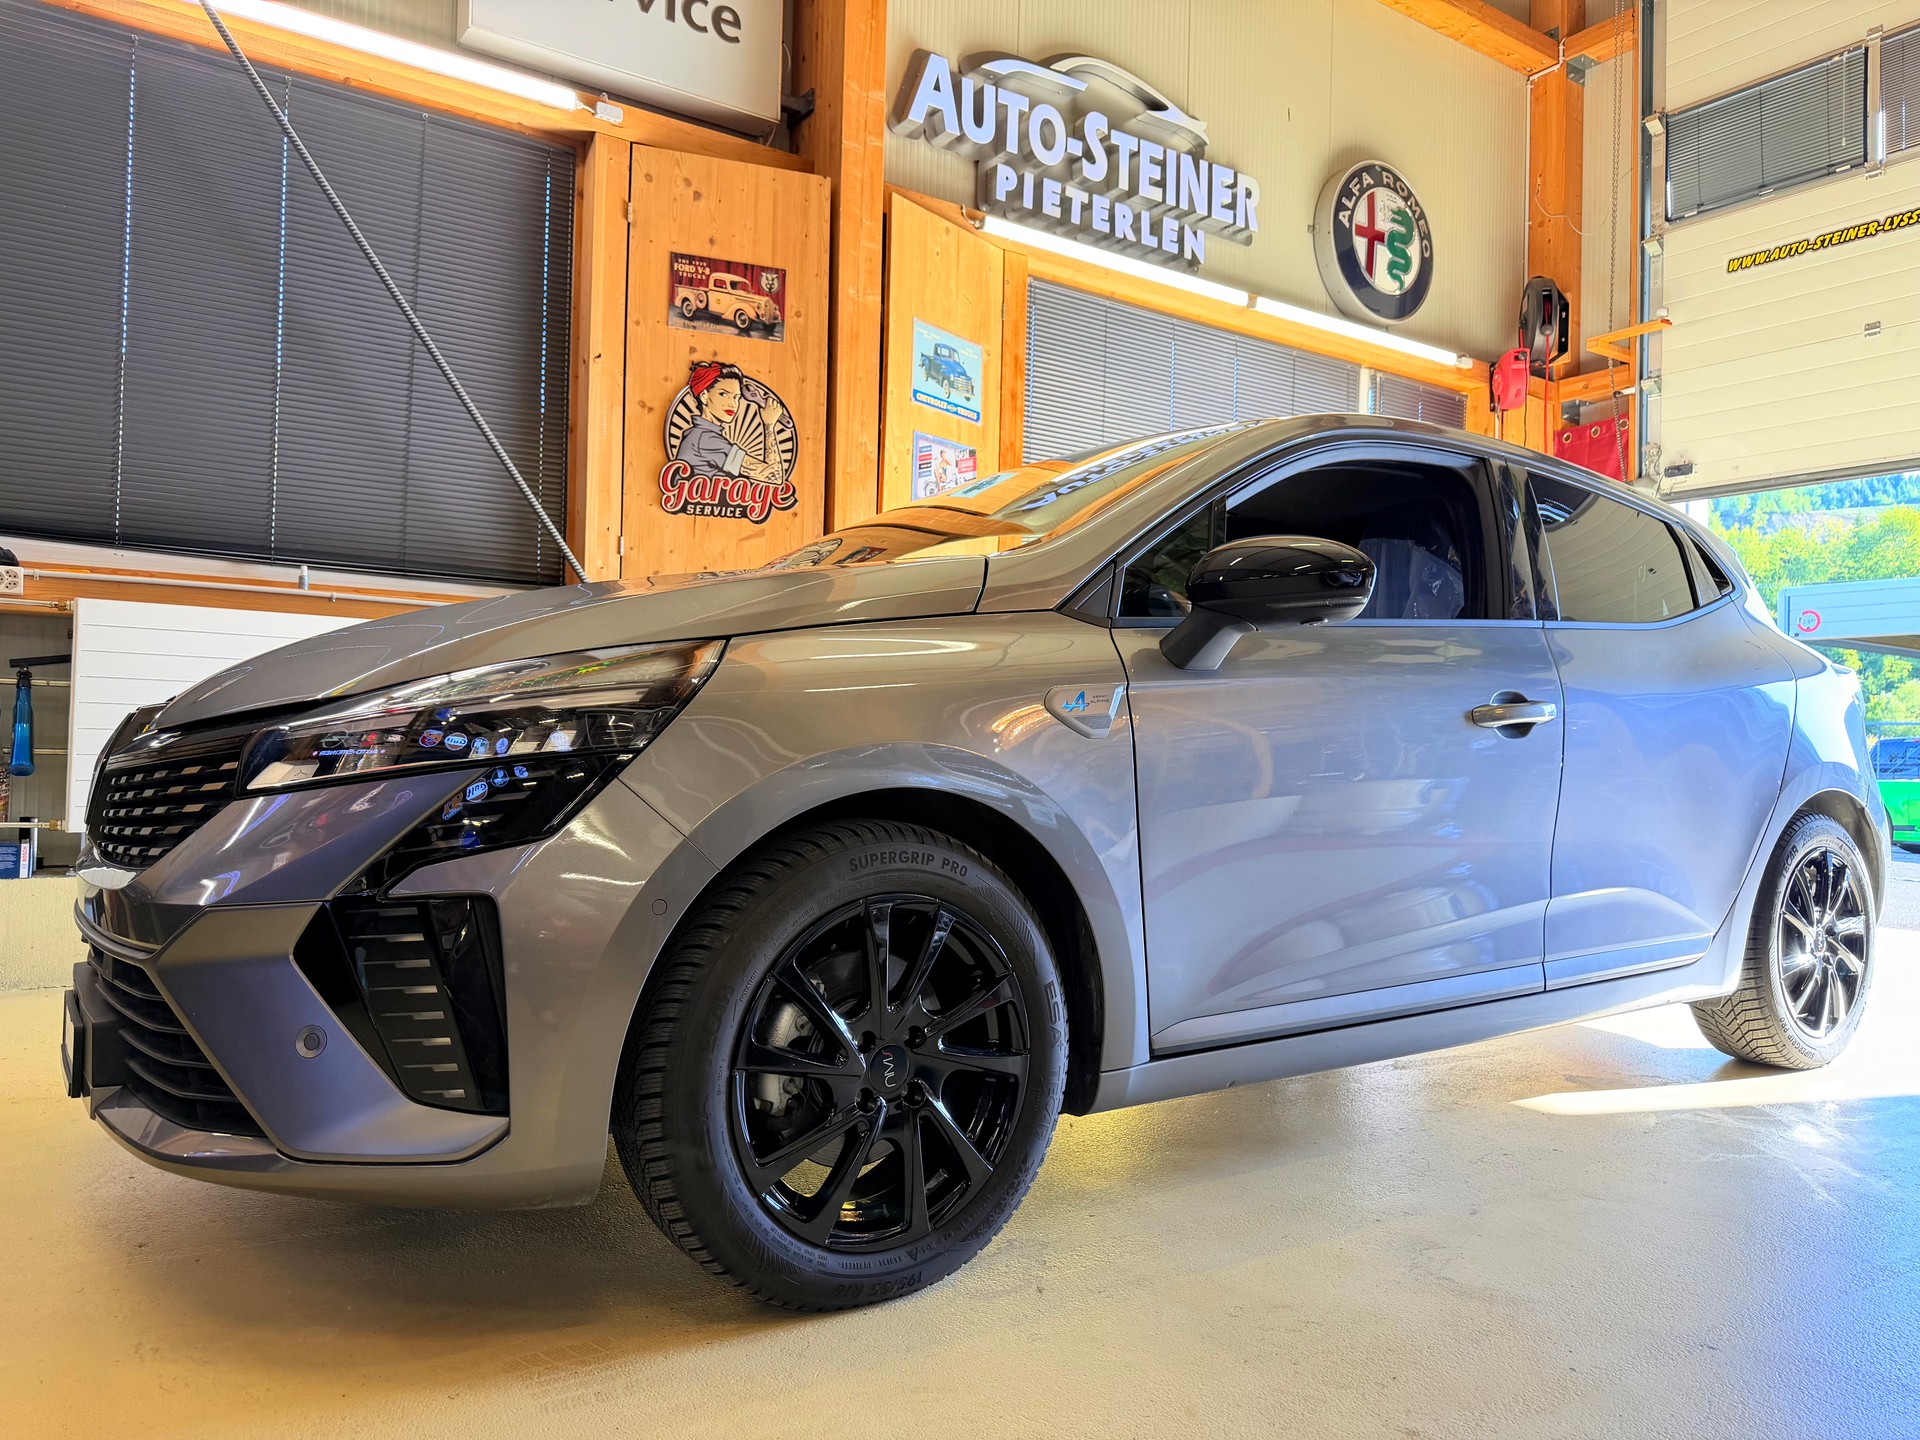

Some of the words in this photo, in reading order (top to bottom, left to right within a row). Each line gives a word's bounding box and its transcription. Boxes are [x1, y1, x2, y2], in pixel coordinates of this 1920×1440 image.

[907, 52, 1261, 233] AUTO-STEINER
[995, 164, 1206, 265] PIETERLEN
[1337, 170, 1376, 230] ALFA
[1380, 169, 1432, 260] ROMEO
[674, 262, 696, 273] FORD
[679, 271, 706, 280] TRUCKS
[660, 460, 796, 521] Garage
[686, 504, 743, 518] SERVICE
[849, 850, 935, 872] SUPERGRIP
[940, 857, 968, 877] PRO
[1780, 844, 1799, 879] TECAR
[1779, 1016, 1790, 1033] PRO
[1787, 1033, 1816, 1060] SUPERGRIP
